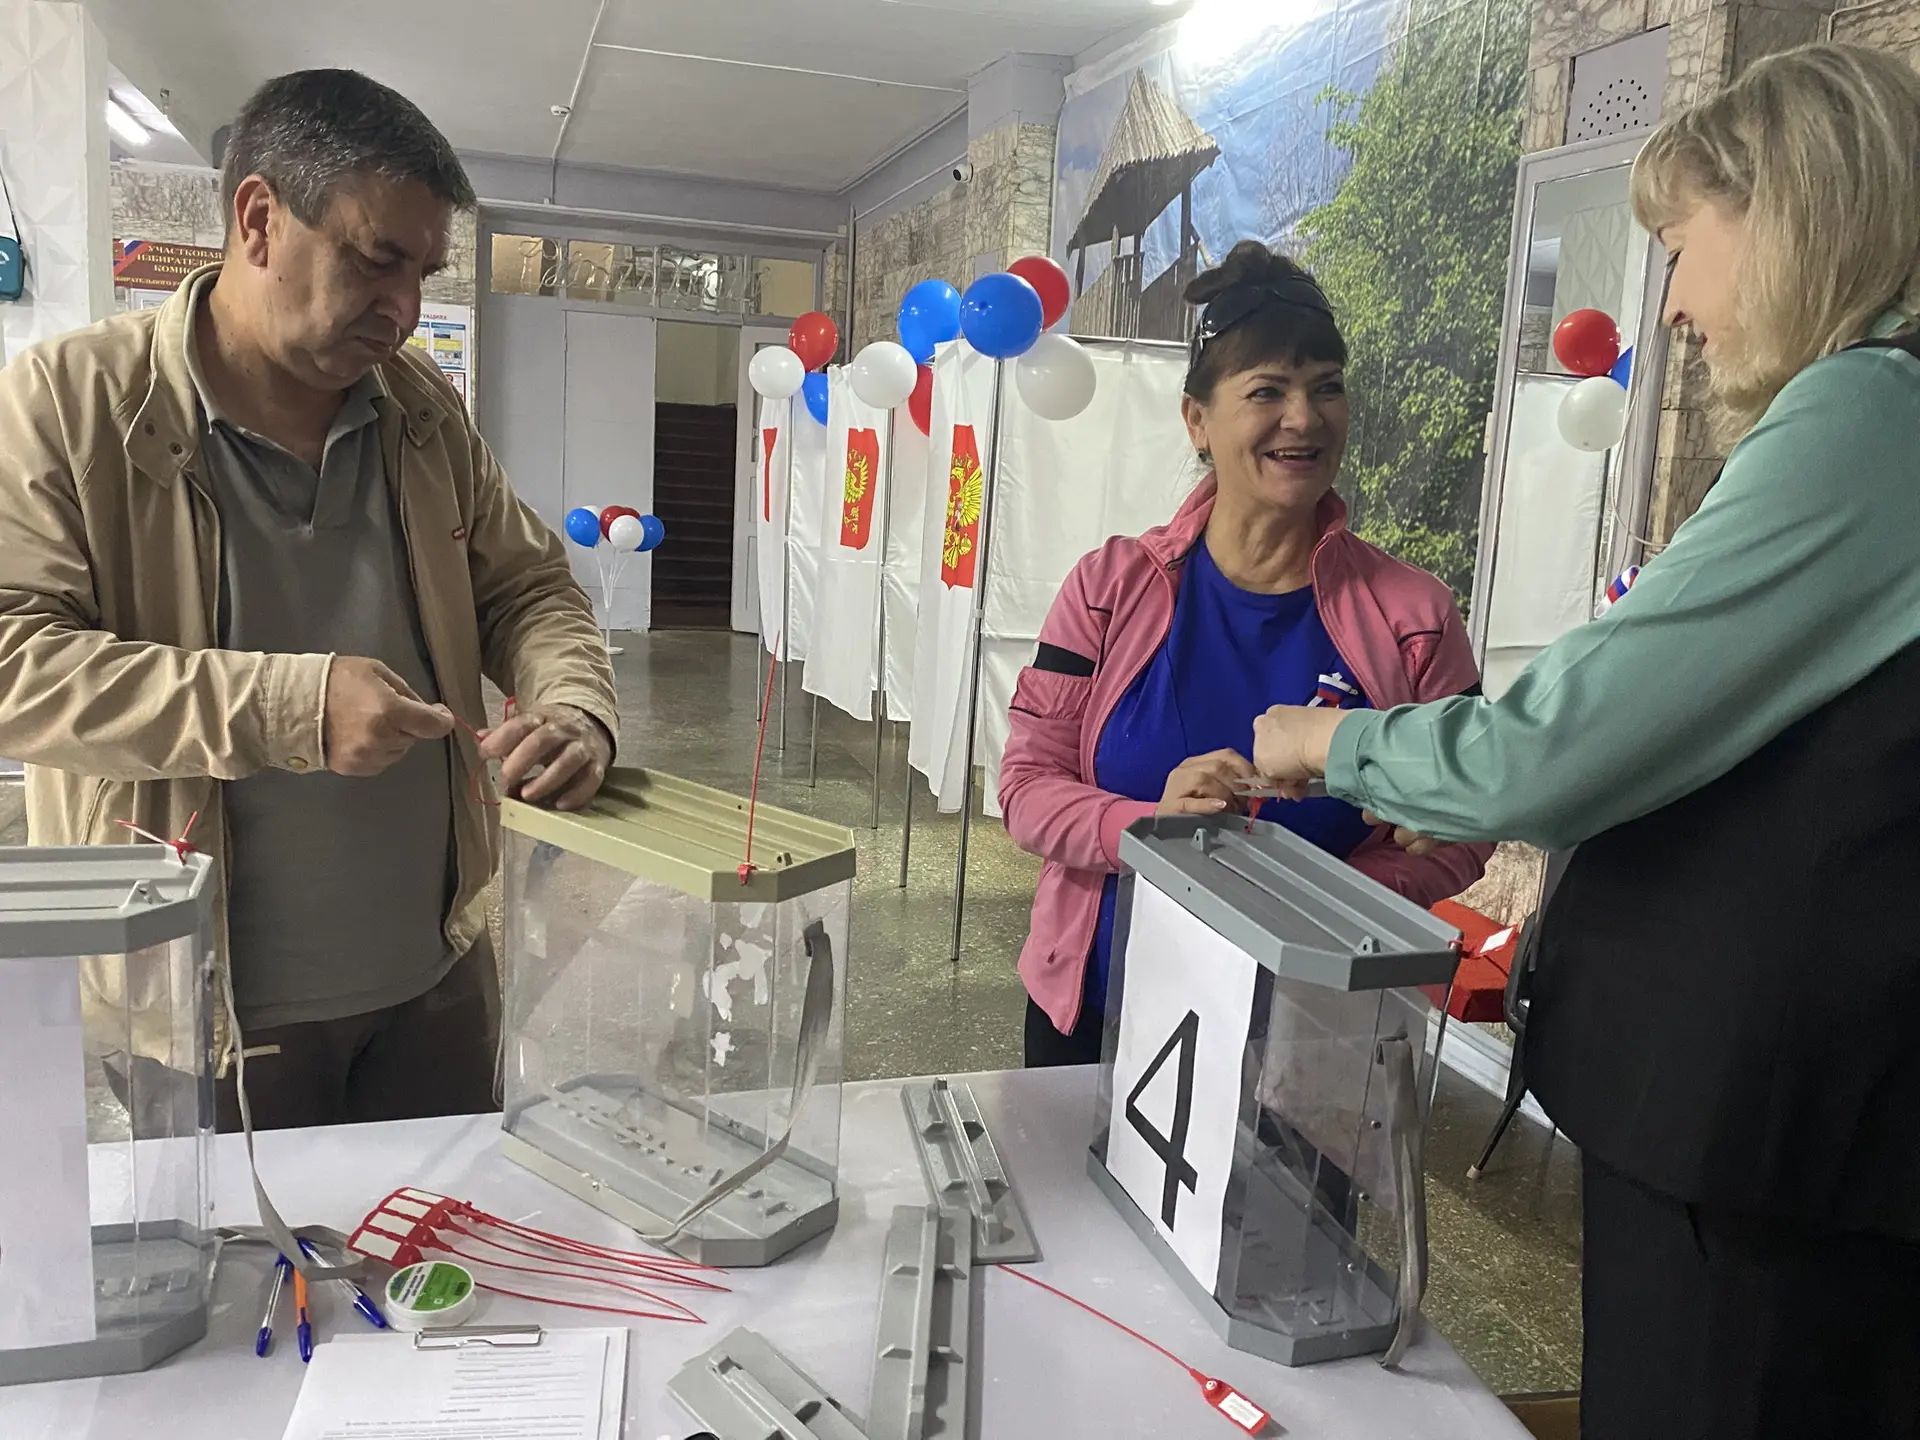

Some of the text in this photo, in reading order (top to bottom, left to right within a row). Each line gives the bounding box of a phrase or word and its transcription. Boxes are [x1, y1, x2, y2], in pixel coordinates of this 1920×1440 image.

[148, 245, 222, 259] УЧАСТКОВАЯ
[154, 264, 192, 274] КОМИС
[1125, 1008, 1200, 1233] 4
